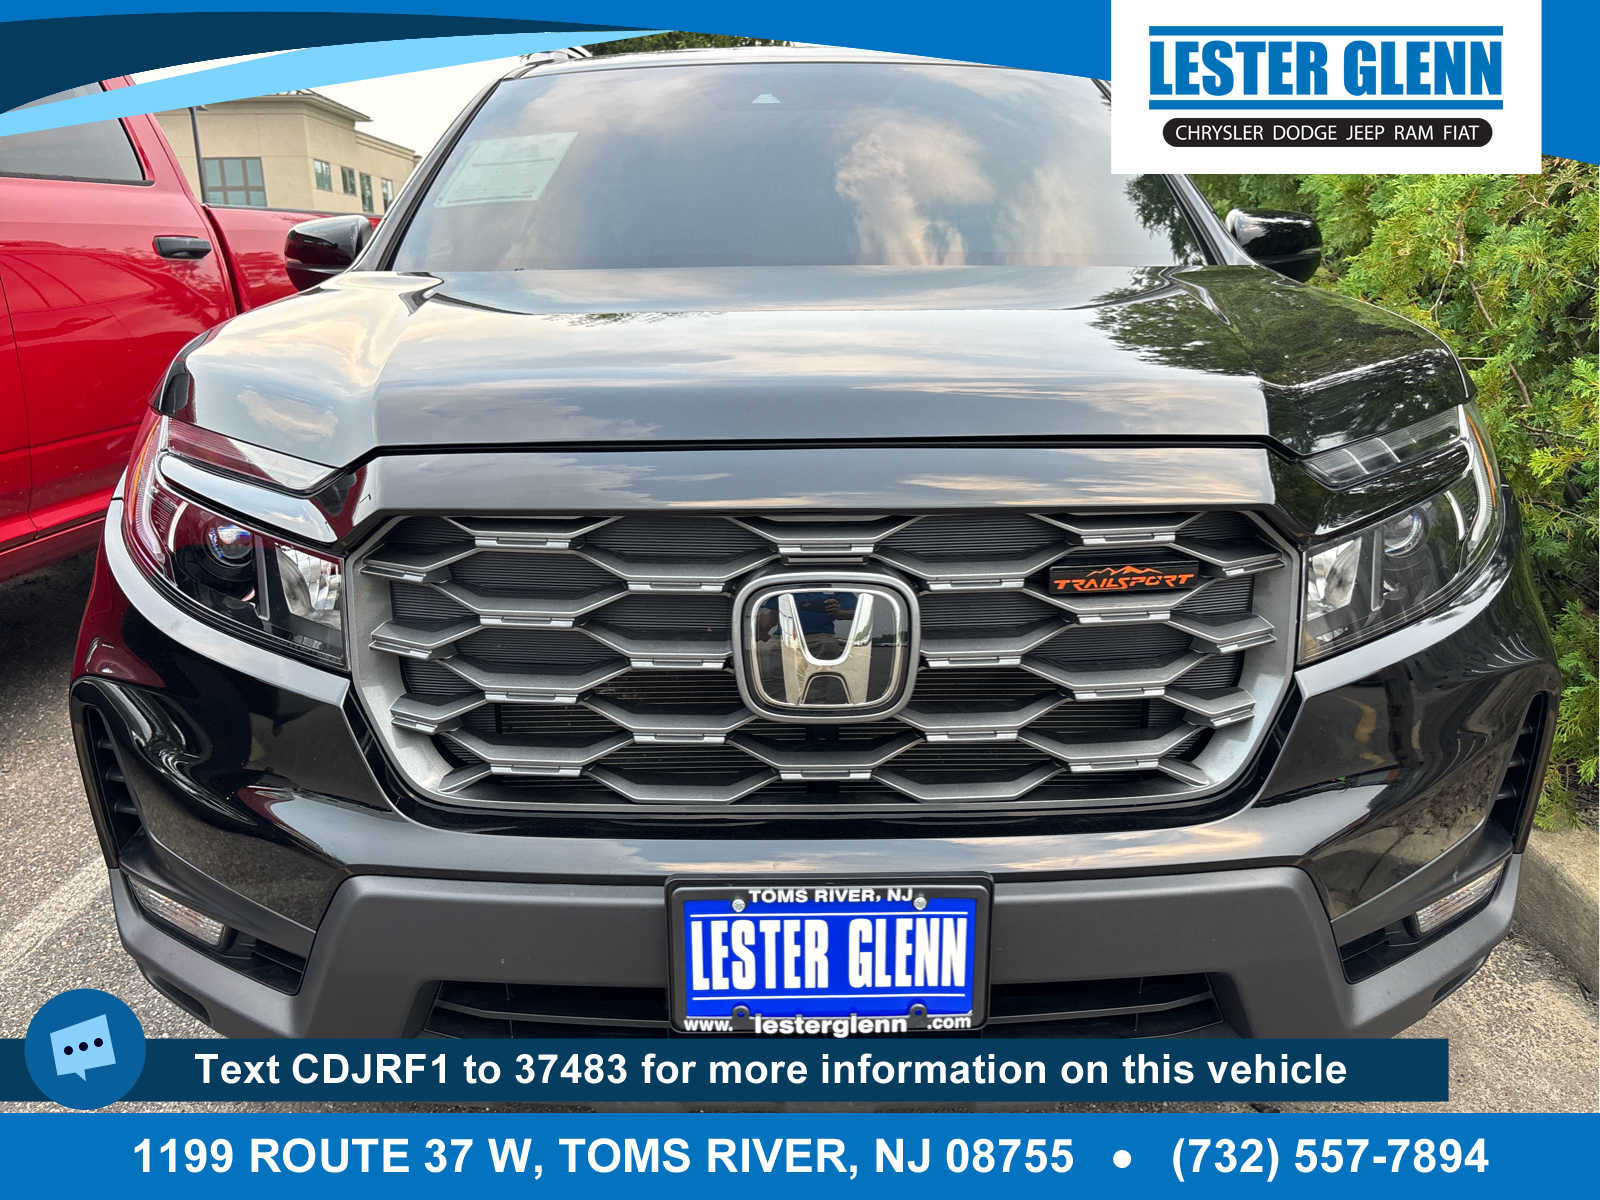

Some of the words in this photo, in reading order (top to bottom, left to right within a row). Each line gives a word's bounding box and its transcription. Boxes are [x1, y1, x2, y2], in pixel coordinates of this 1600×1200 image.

[1053, 573, 1195, 592] TRAILSPORT
[748, 888, 809, 904] TOMS
[814, 888, 882, 903] RIVER,
[887, 888, 914, 902] NJ
[690, 918, 830, 992] LESTER
[848, 917, 968, 989] GLENN
[683, 1018, 734, 1033] www.
[754, 1013, 908, 1039] lesterglenn
[926, 1015, 972, 1031] .com
